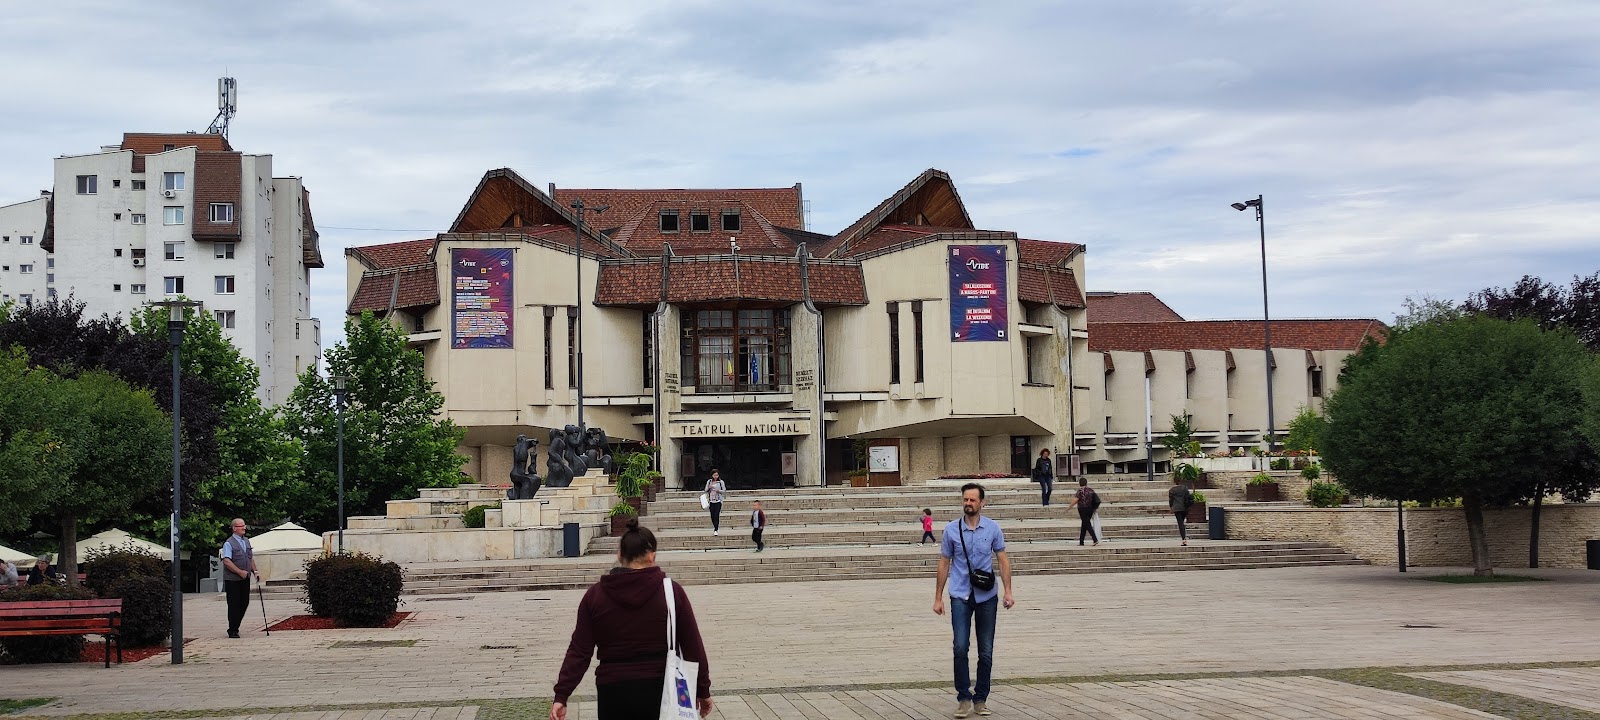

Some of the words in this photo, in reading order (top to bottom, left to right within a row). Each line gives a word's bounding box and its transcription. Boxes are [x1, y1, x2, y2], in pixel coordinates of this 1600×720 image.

[966, 260, 989, 269] VIBE
[681, 425, 734, 435] TEATRUL
[745, 423, 800, 434] NATIONAL
